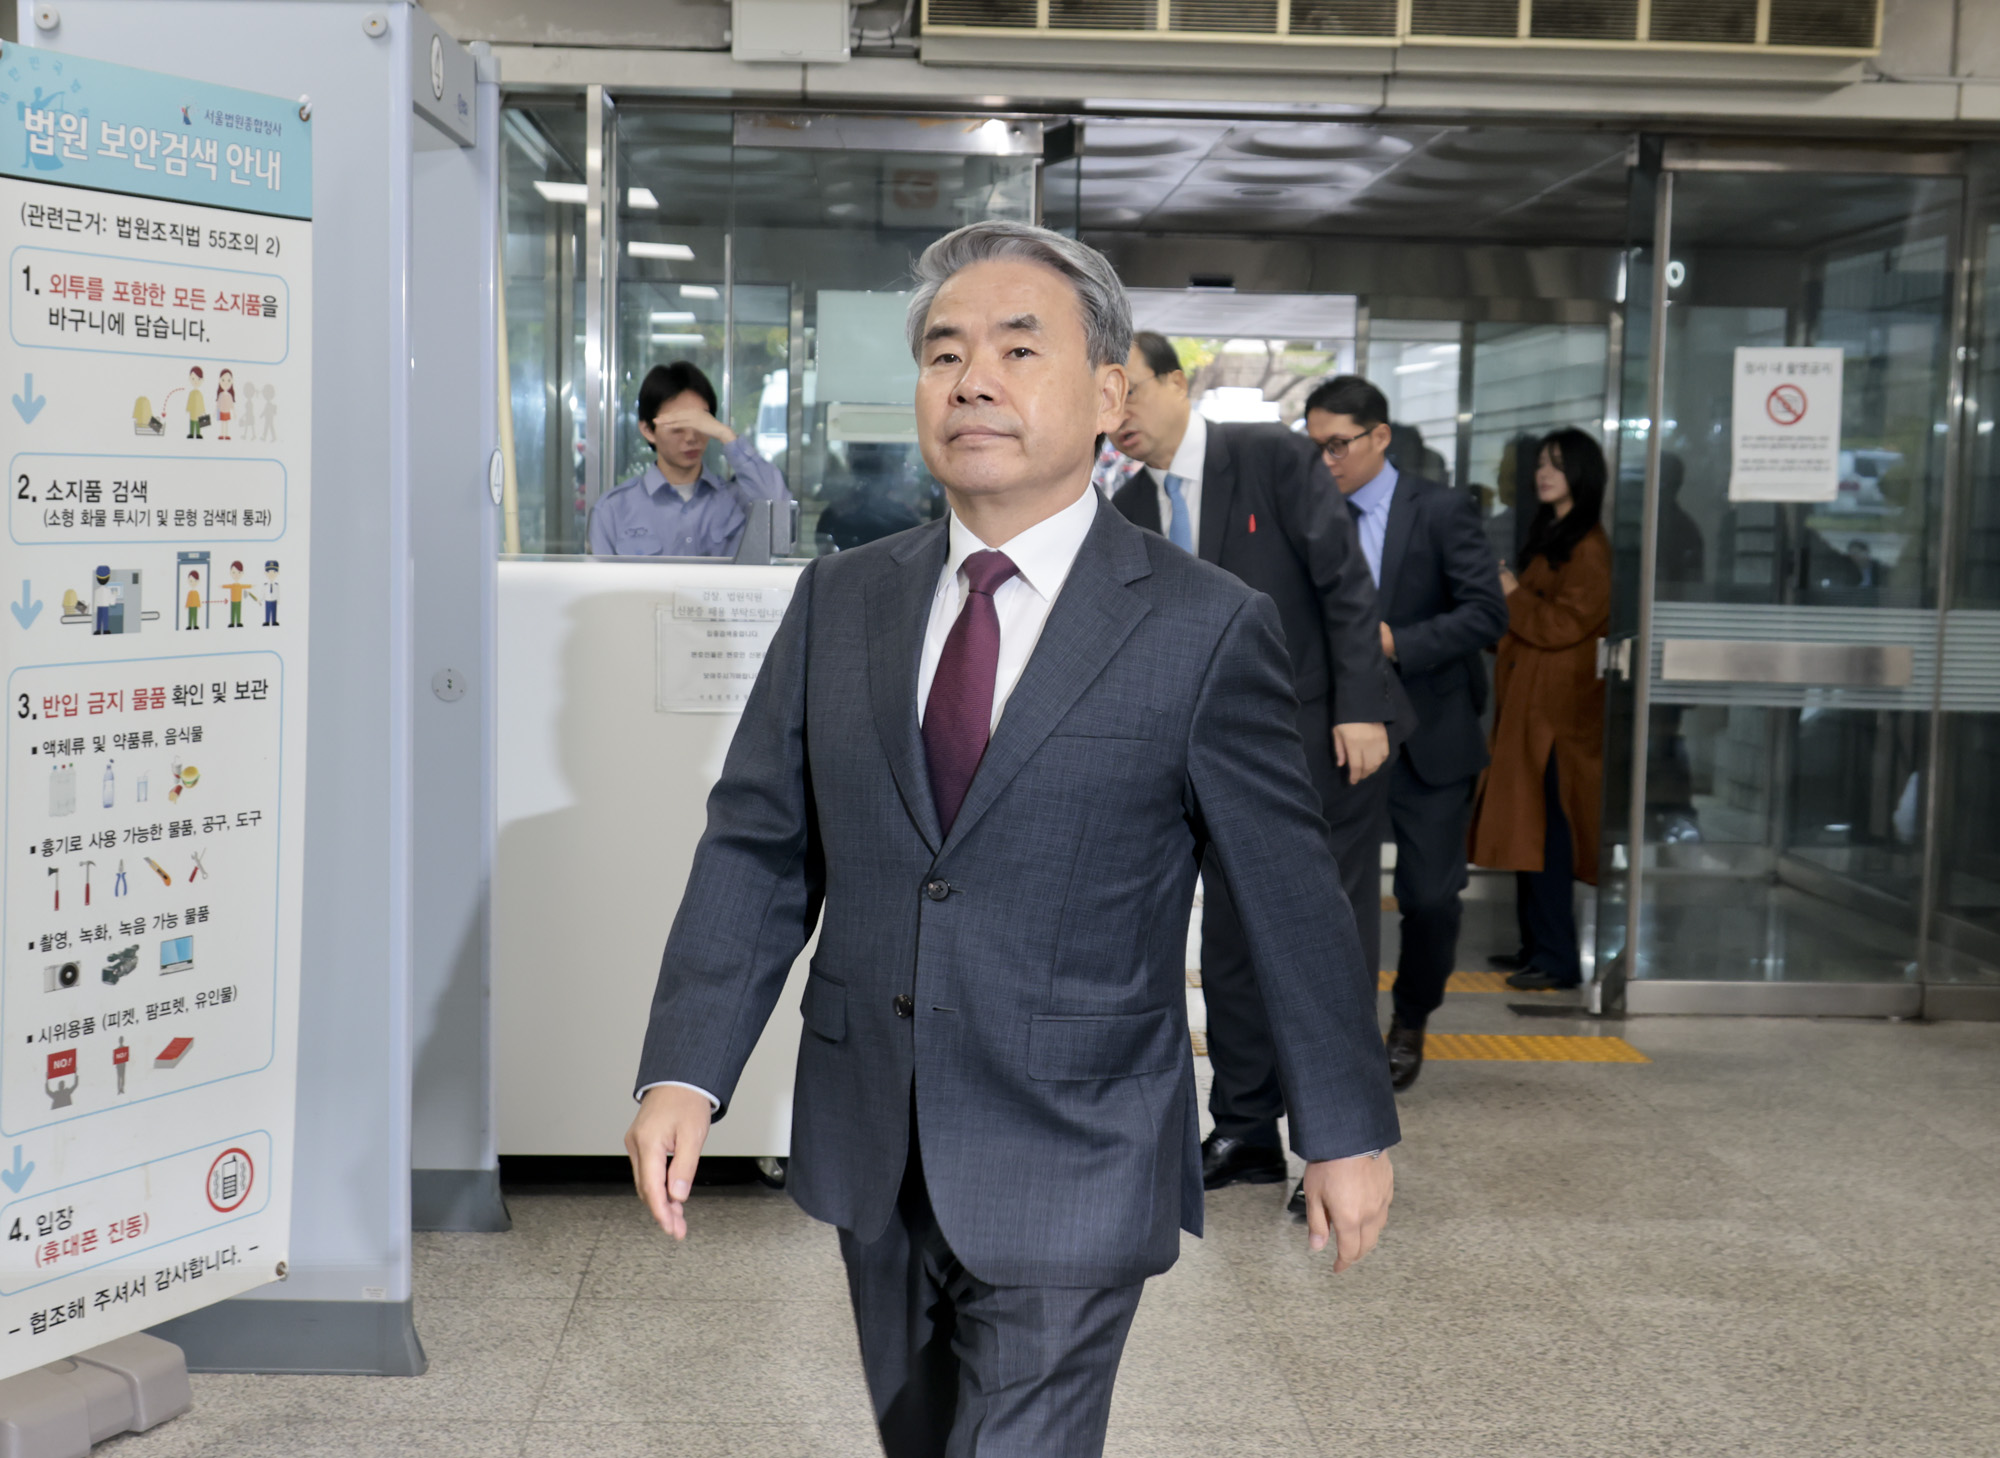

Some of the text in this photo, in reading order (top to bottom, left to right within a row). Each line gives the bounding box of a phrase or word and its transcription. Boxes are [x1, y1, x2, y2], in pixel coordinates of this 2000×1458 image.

[204, 109, 282, 136] 서울법원종합청사
[24, 107, 281, 191] 법원 보안검색 안내
[21, 202, 281, 257] (관련근거: 법원조직법 55조의 2)
[22, 265, 278, 318] 1. 외투를 포함한 모든 소지품을
[49, 307, 210, 342] 바구니에 담습니다.
[17, 474, 148, 503] 2. 소지품 검색
[43, 508, 272, 528] (소형 화물 투시기 및 문형 검색대 통과)
[17, 678, 269, 720] 3. 반입 금지 물품 확인 및 보관
[42, 725, 204, 758] 액체류 및 약품류, 음식물
[40, 809, 263, 858] 흉기로 사용 가능한 물품, 공구, 도구
[39, 905, 210, 953] 촬영, 녹화, 녹음 가능 물품
[38, 985, 238, 1044] 시위용품 (피켓, 팜프렛, 유인물)
[53, 1056, 73, 1070] NO!
[8, 1206, 75, 1243] 4. 입장
[34, 1212, 150, 1268] (휴대폰 진동)
[29, 1297, 86, 1336] 협조해
[93, 1275, 147, 1311] 주셔서
[154, 1245, 242, 1291] 감사합니다.
